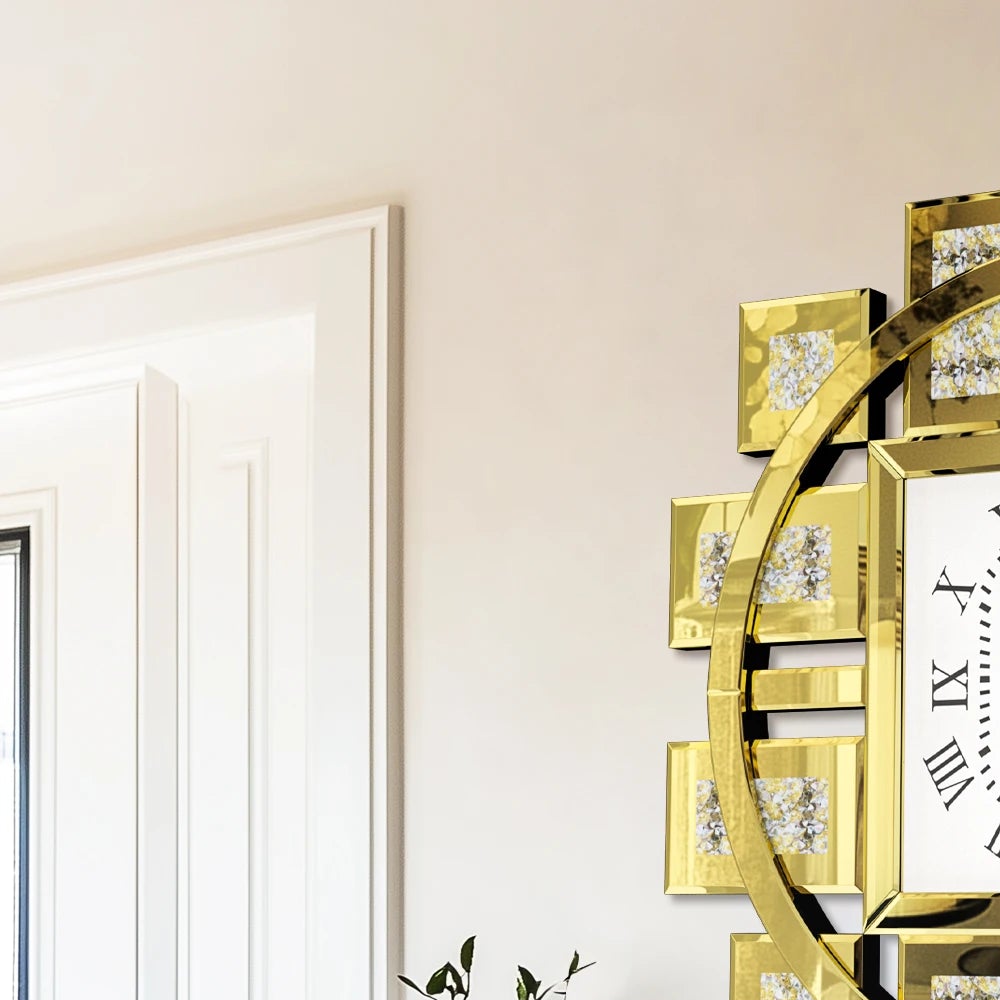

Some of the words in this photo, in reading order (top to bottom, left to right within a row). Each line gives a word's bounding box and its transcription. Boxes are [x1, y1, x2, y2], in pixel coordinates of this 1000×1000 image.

[931, 565, 977, 616] X
[932, 659, 968, 711] IX
[922, 736, 975, 811] VIII
